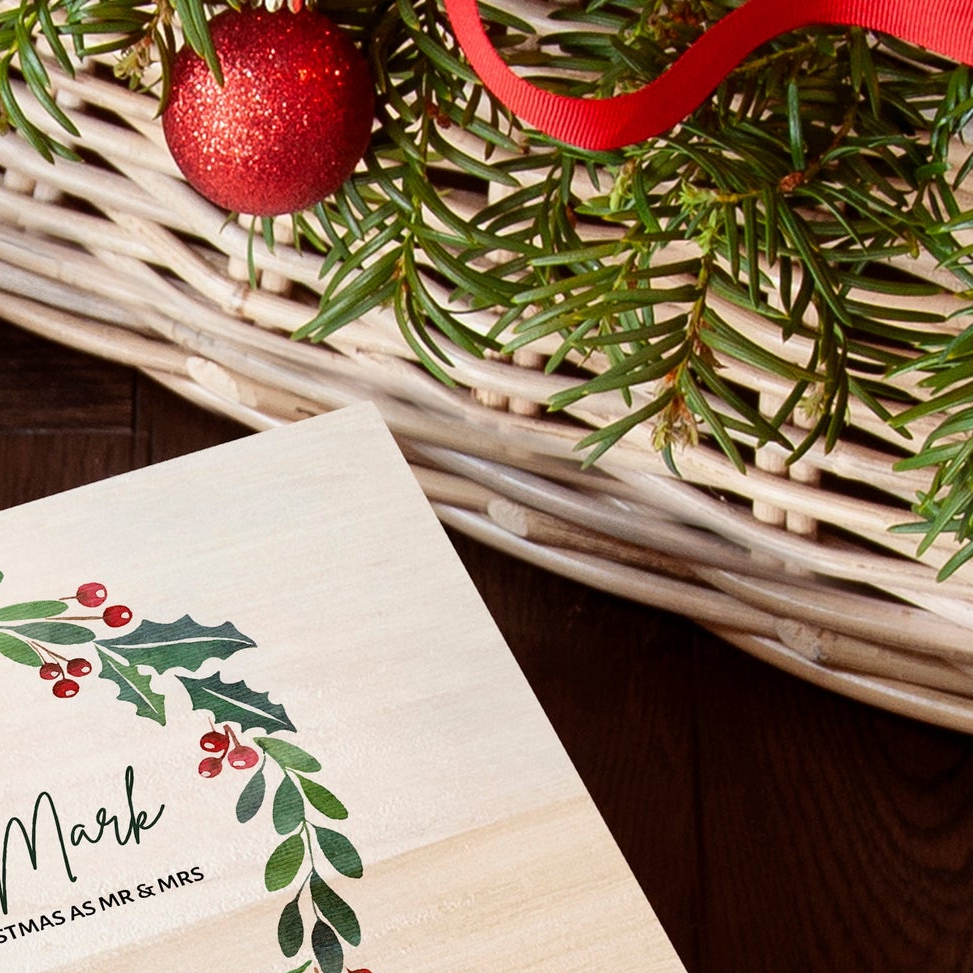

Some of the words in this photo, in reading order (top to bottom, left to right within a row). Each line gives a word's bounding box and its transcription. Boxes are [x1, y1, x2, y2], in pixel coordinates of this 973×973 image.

[69, 900, 97, 923] AS
[98, 889, 136, 912] MR
[136, 883, 157, 899] &
[157, 866, 205, 893] MRS
